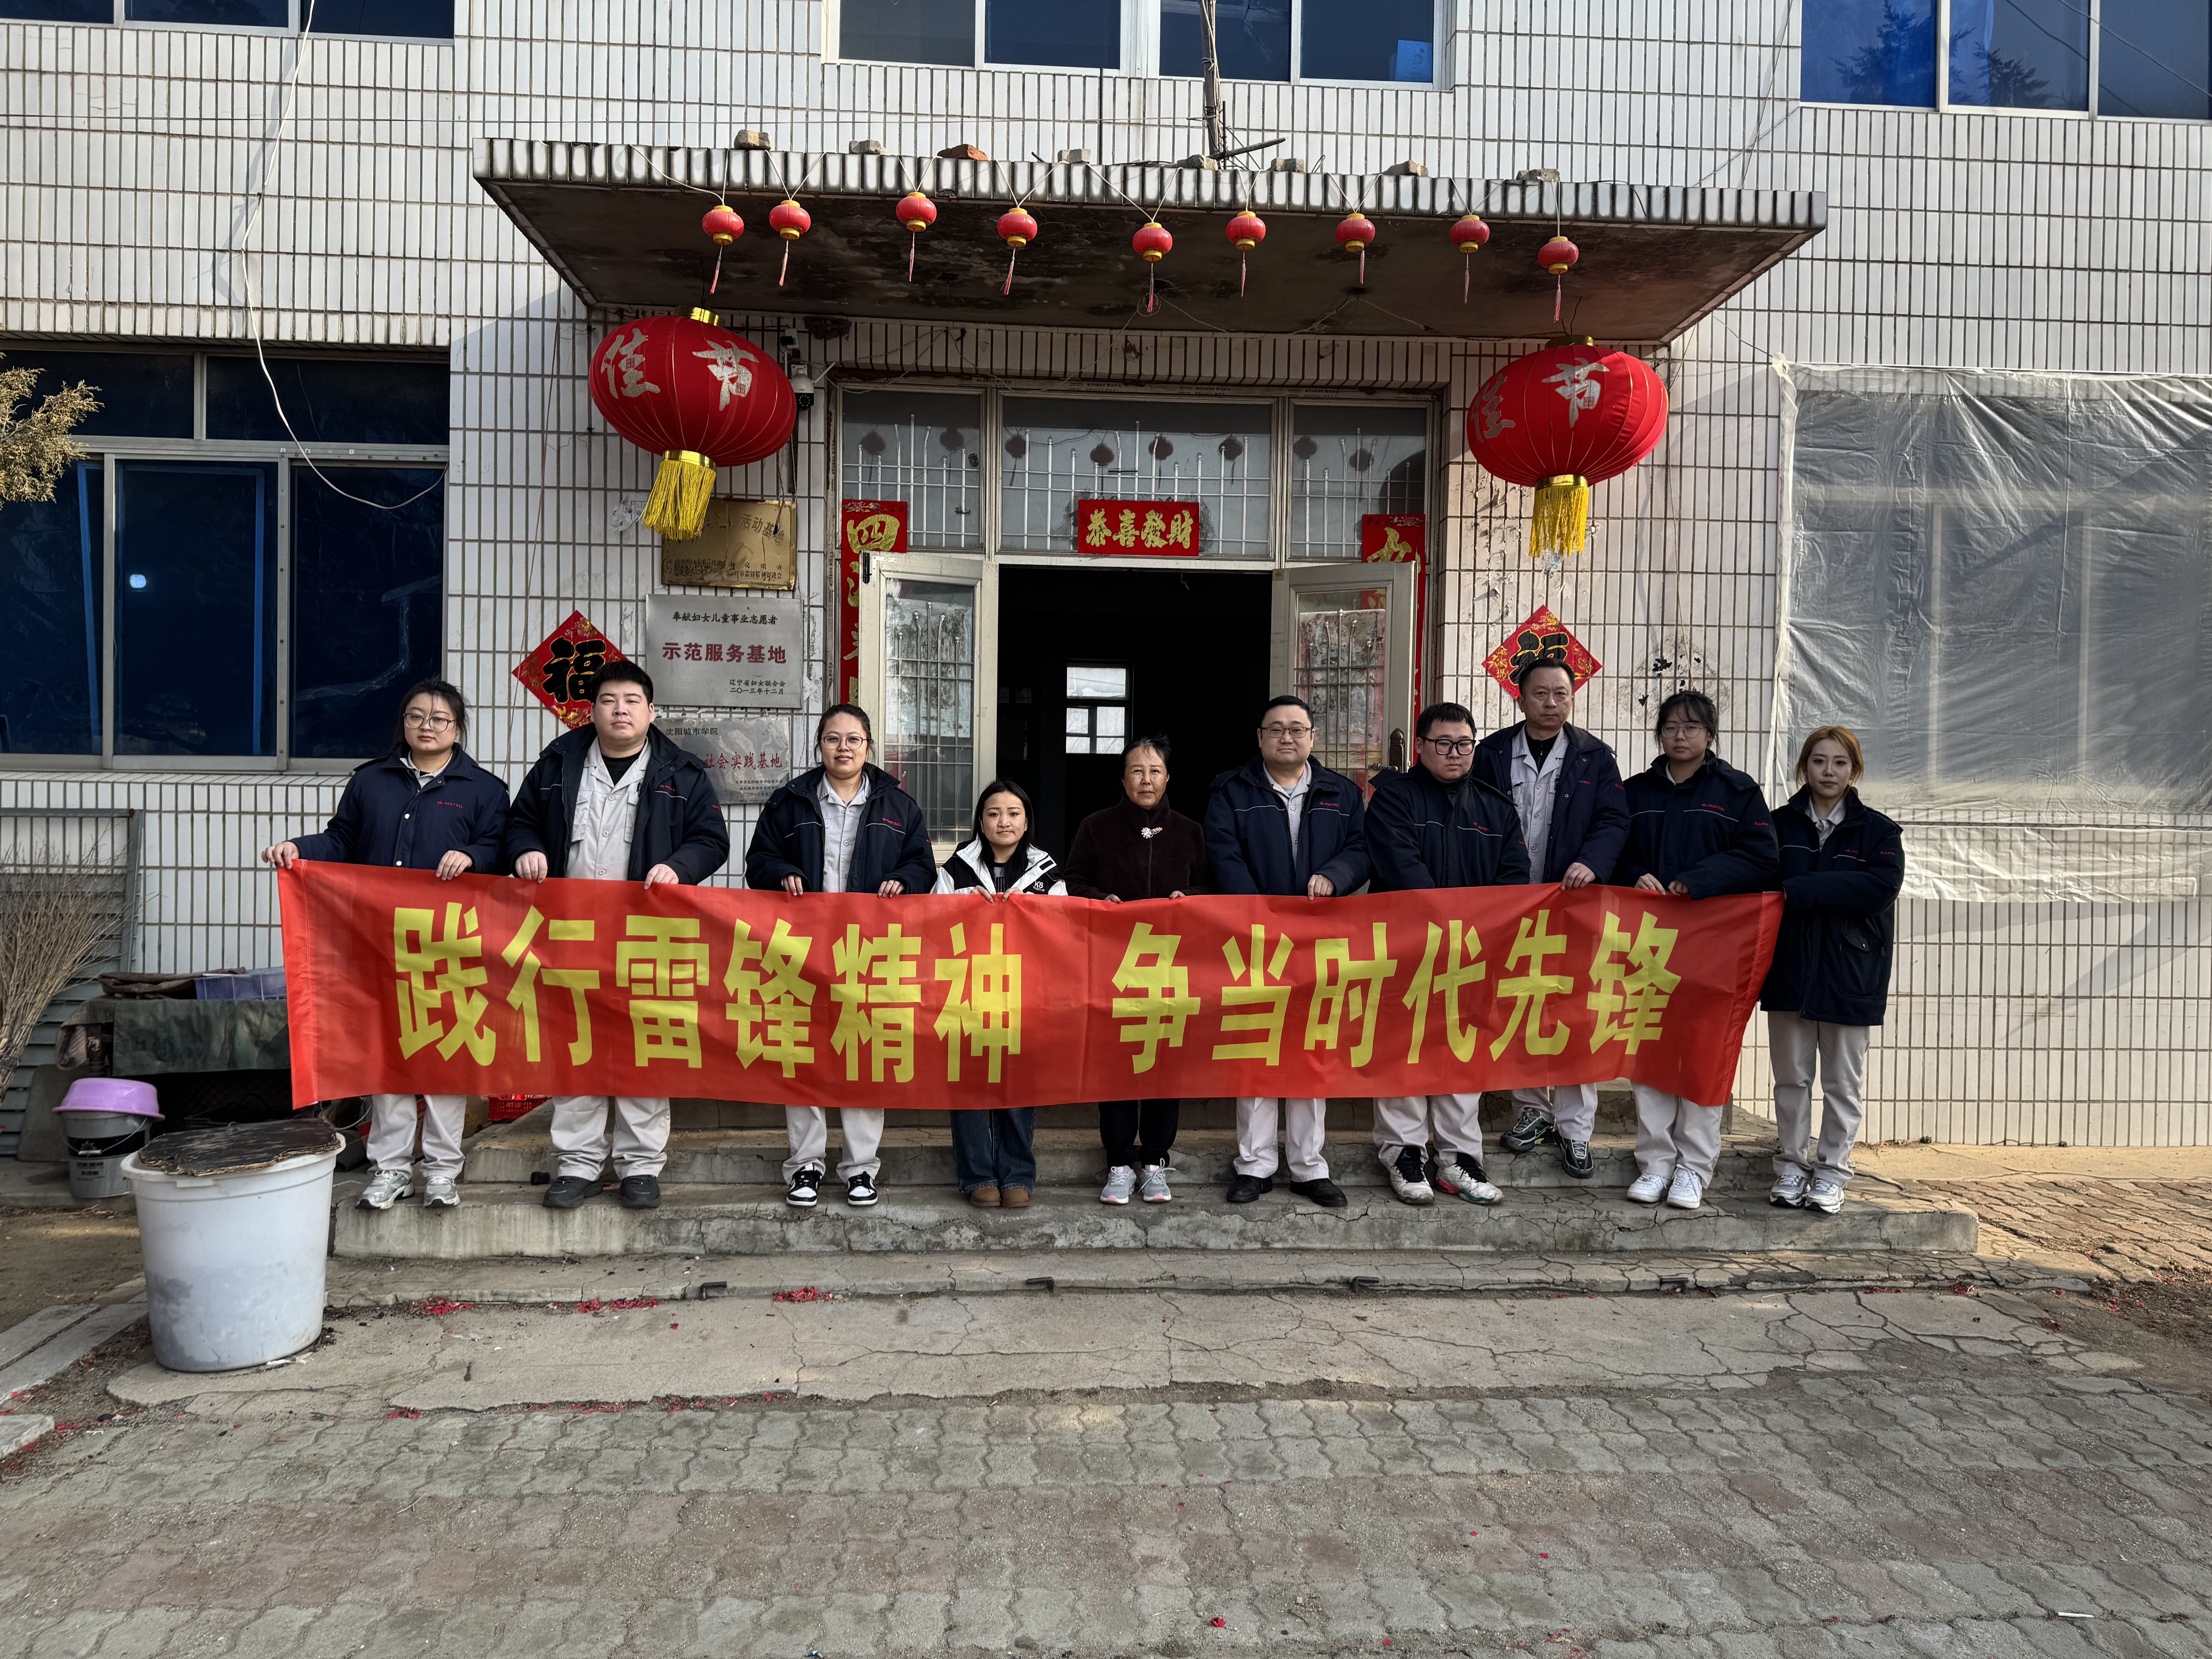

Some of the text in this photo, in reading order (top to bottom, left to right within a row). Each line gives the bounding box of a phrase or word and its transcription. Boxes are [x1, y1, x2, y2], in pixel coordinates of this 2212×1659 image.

[1086, 508, 1193, 549] 恭喜發財
[672, 611, 778, 625] 奉献妇女儿童事业志愿者
[663, 642, 787, 664] 示范服务基地
[730, 679, 786, 687] 辽宁省妇女联合会
[666, 727, 718, 735] 沈阳城市学院
[1034, 880, 1044, 888] KS
[393, 902, 1681, 1083] 践行雷锋精神 争当时代先锋
